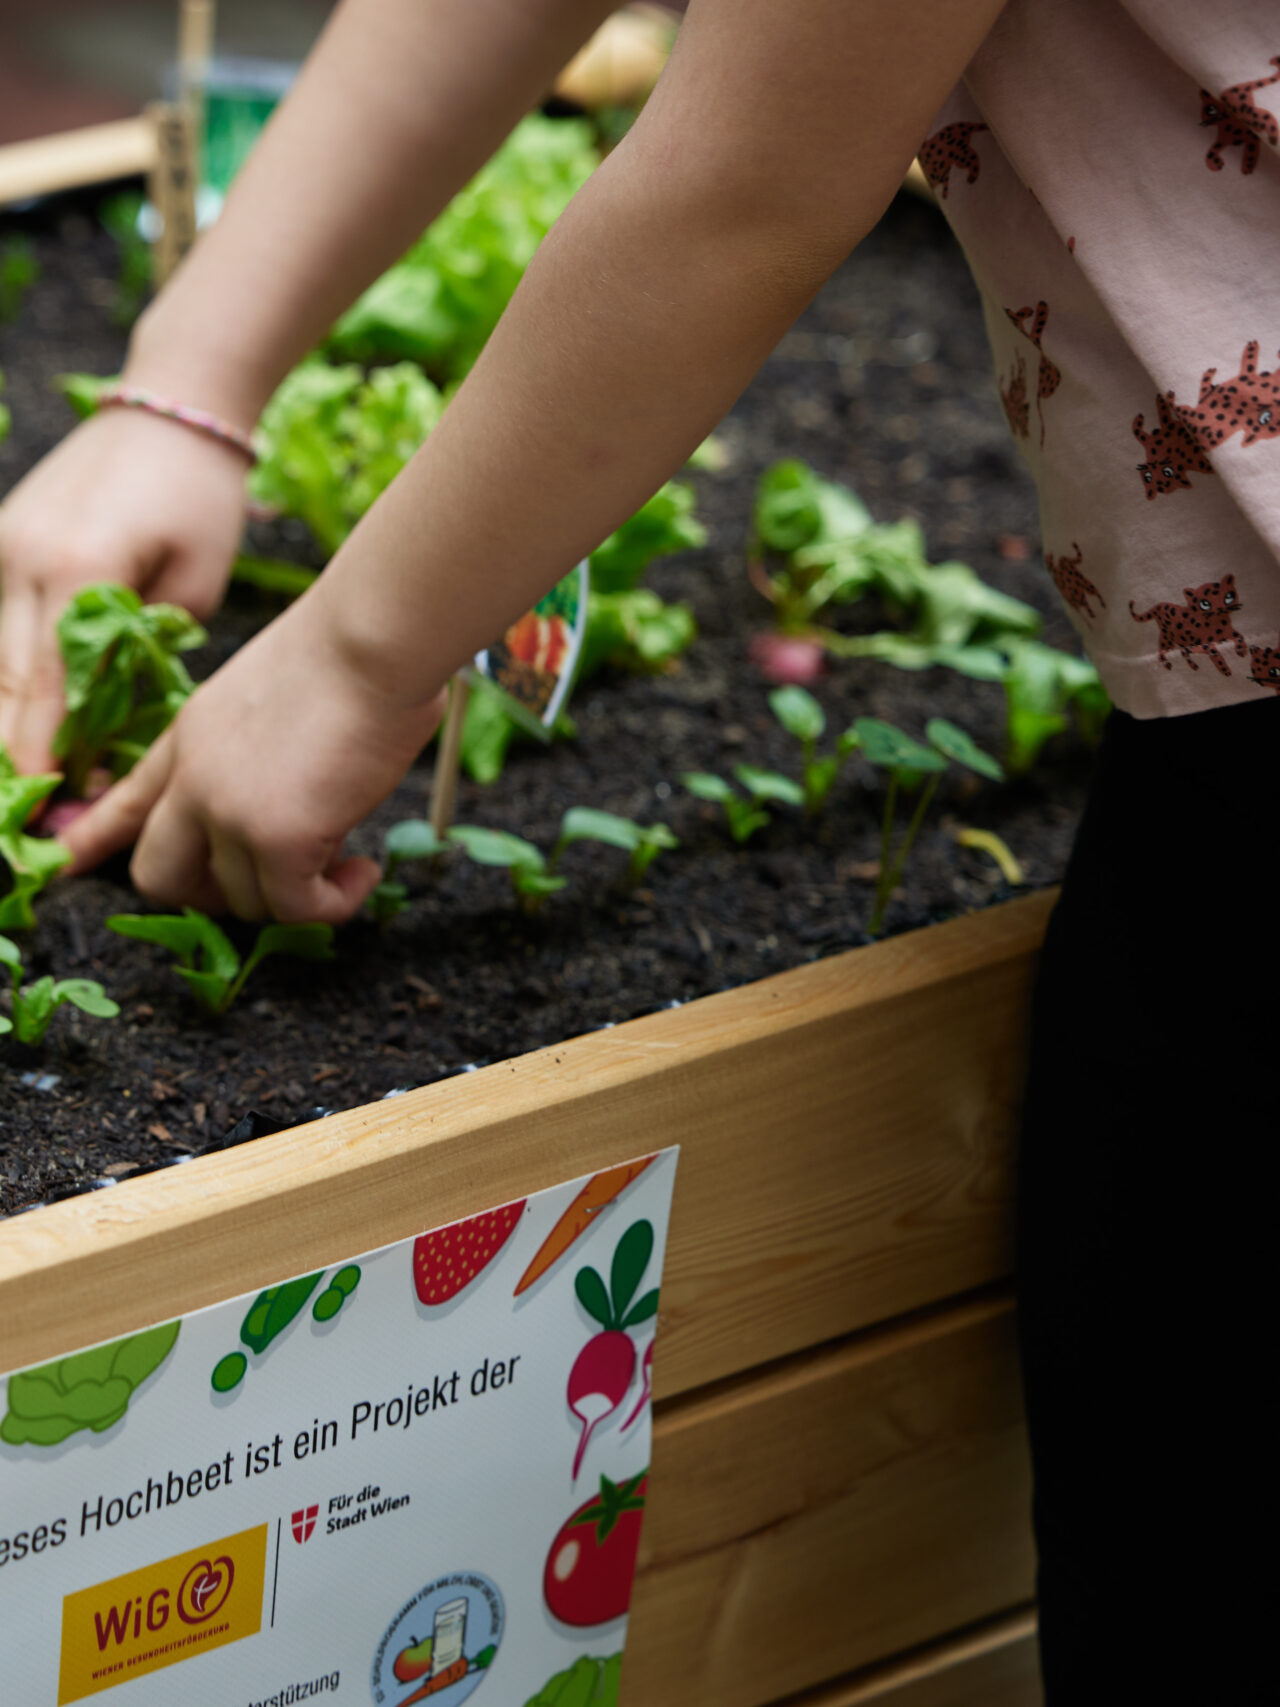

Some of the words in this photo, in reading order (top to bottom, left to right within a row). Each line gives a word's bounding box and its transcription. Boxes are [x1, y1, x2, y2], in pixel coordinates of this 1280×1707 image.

[80, 1450, 235, 1537] Hochbeet
[245, 1433, 283, 1478] ist
[293, 1418, 339, 1460] ein
[351, 1370, 461, 1440] Projekt
[470, 1355, 521, 1397] der
[326, 1508, 367, 1534] Stadt
[370, 1494, 410, 1517] Wien
[328, 1494, 353, 1514] Für
[356, 1484, 380, 1503] die
[94, 1588, 170, 1652] WiG
[92, 1661, 124, 1681] WIENER
[127, 1621, 230, 1667] GESUNDHEITSFÖRDERUNG
